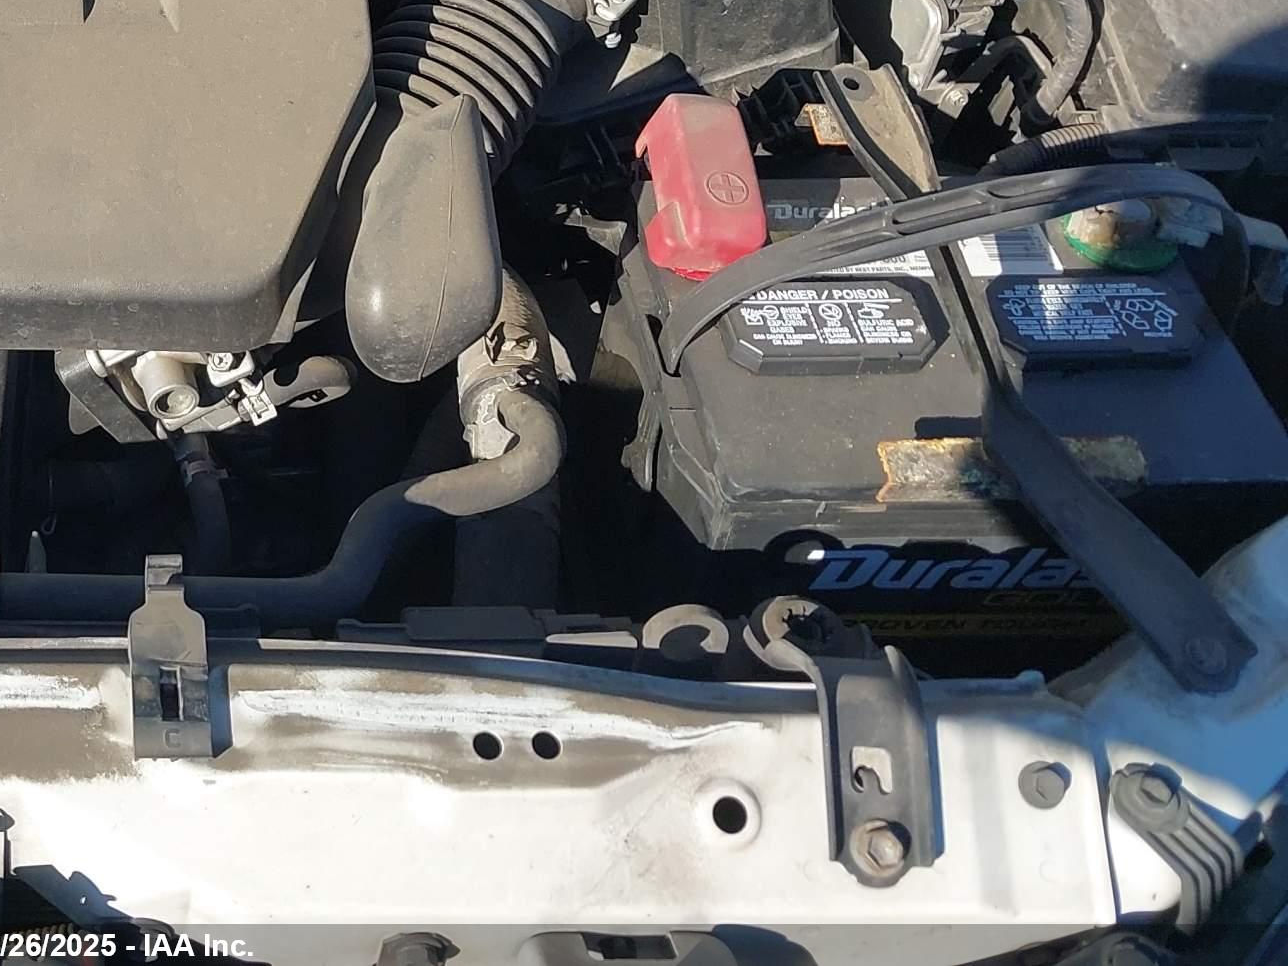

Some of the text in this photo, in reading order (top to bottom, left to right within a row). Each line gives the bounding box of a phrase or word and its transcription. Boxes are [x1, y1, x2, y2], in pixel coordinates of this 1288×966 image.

[757, 288, 890, 301] DANGER / POISON
